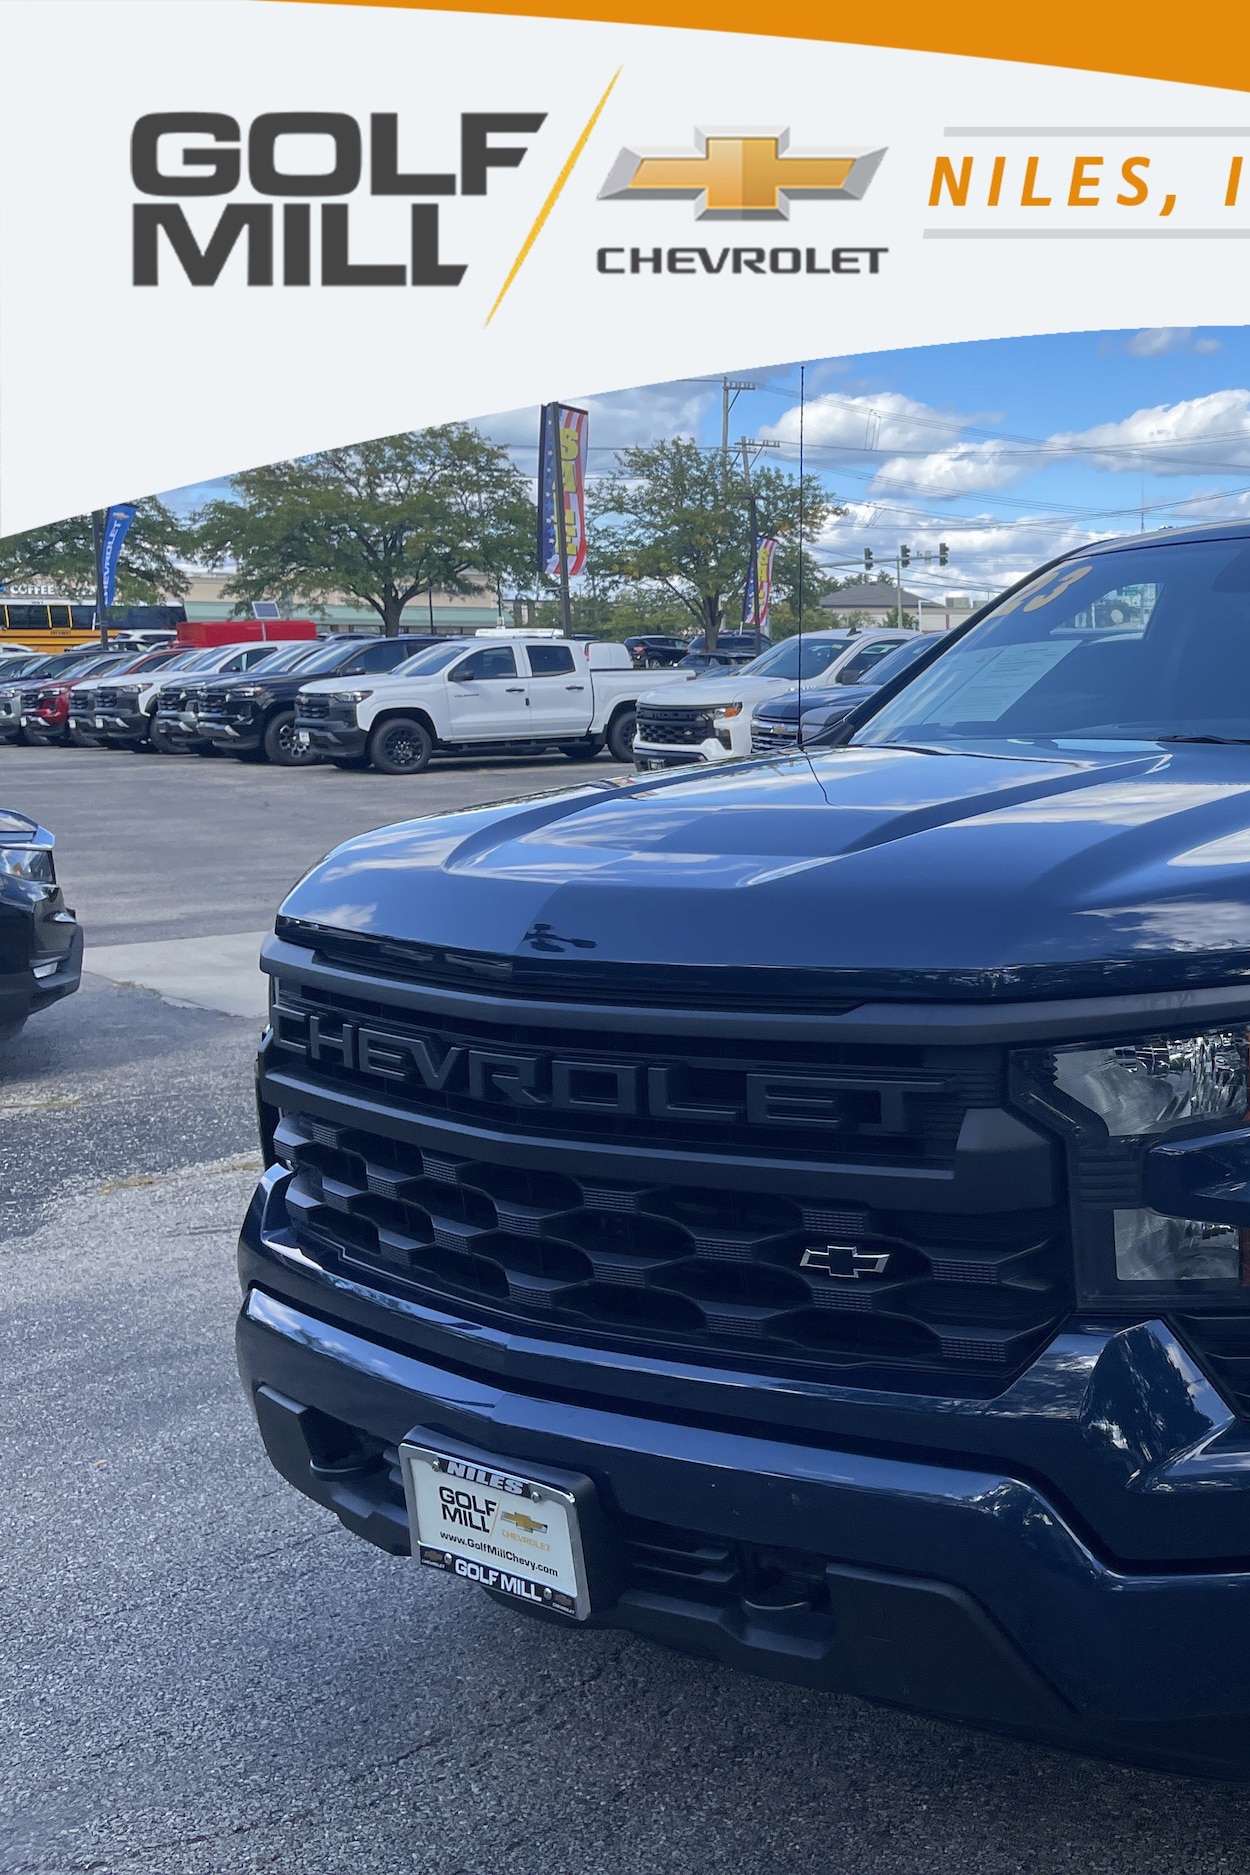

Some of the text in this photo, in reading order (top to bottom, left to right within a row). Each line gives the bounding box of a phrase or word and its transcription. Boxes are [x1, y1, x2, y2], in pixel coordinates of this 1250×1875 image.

[10, 584, 55, 595] COFFEE
[272, 1004, 946, 1133] CHEVROLET
[447, 1461, 523, 1495] NILES
[439, 1486, 497, 1516] GOLF
[441, 1503, 490, 1534] MILL
[440, 1530, 558, 1577] www.GolfMillChevy.com
[501, 1530, 551, 1551] CHEVROLET
[455, 1558, 542, 1602] GOLF MILL
